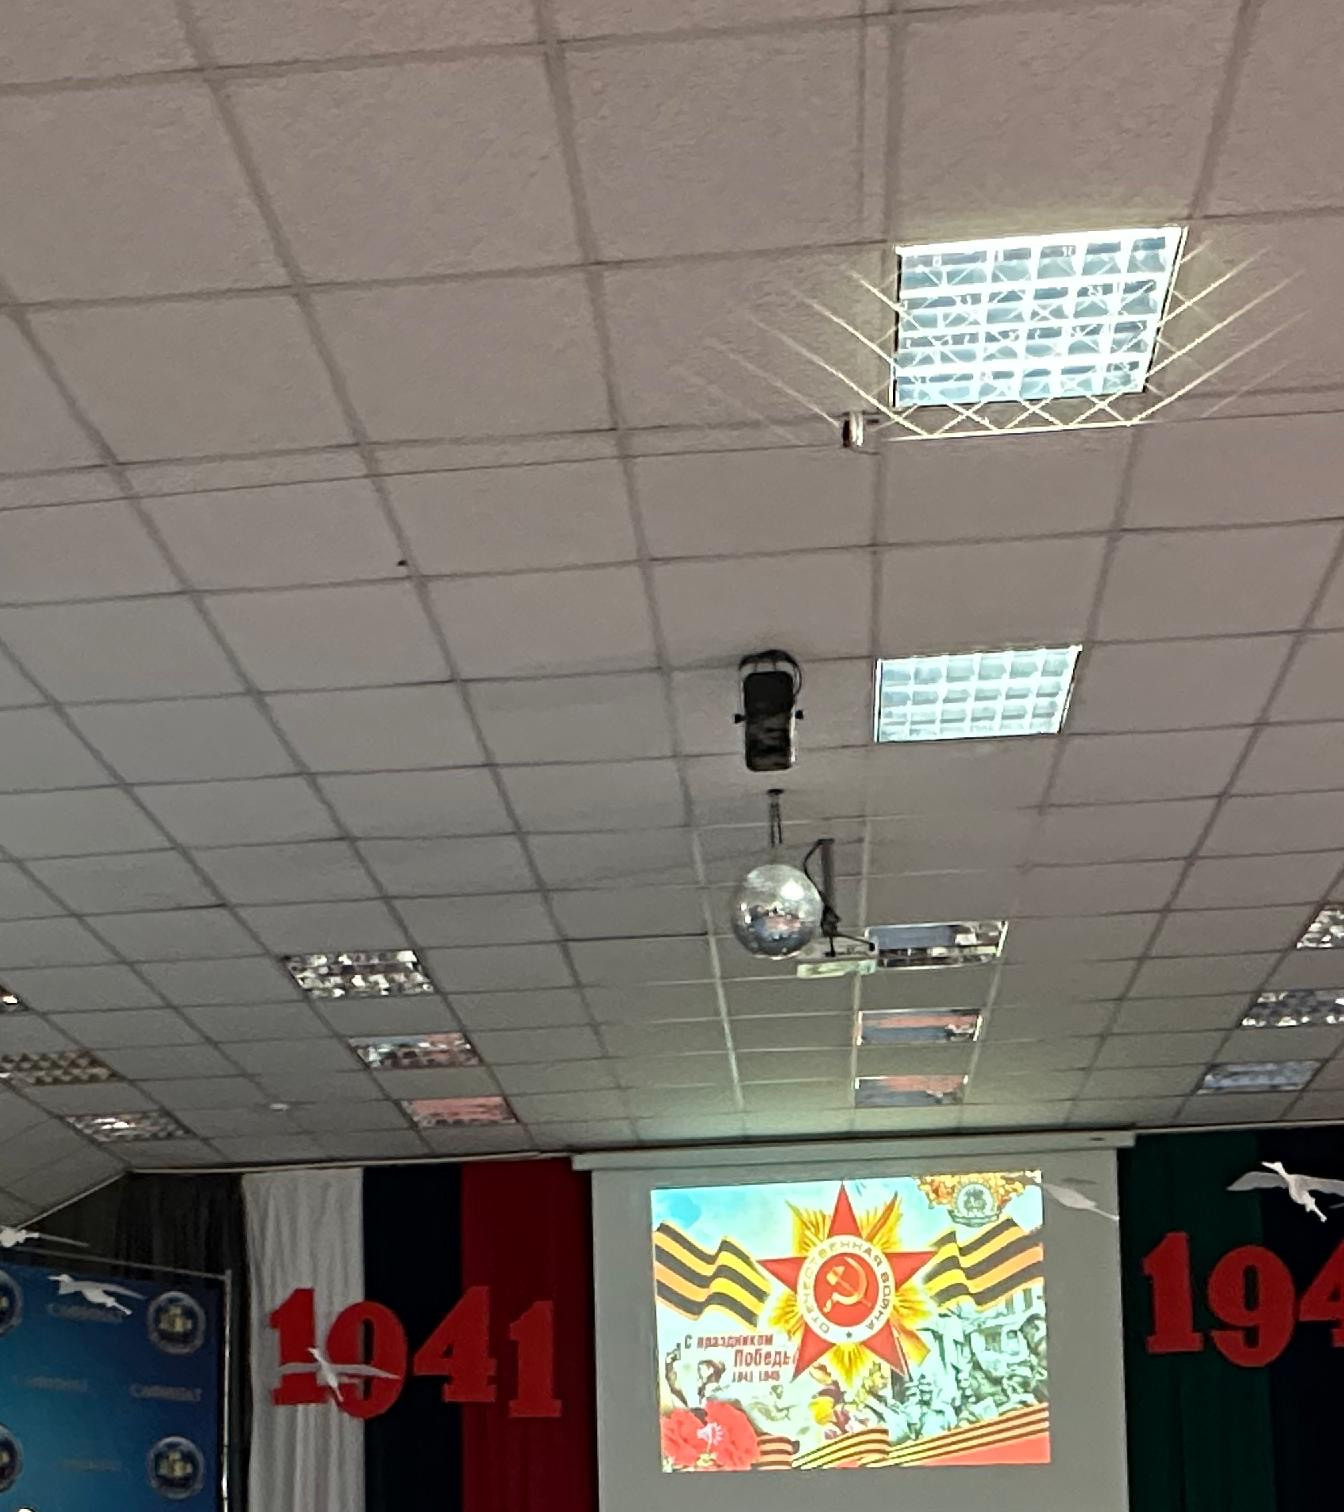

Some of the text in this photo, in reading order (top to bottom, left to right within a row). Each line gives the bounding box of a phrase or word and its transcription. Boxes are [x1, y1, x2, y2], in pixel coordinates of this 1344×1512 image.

[803, 1240, 891, 1334] ОТЕЧЕСТВЕННАЯ ВОЙНА
[268, 1286, 562, 1421] 1941
[684, 1334, 773, 1350] С праздником
[734, 1348, 796, 1368] Победы
